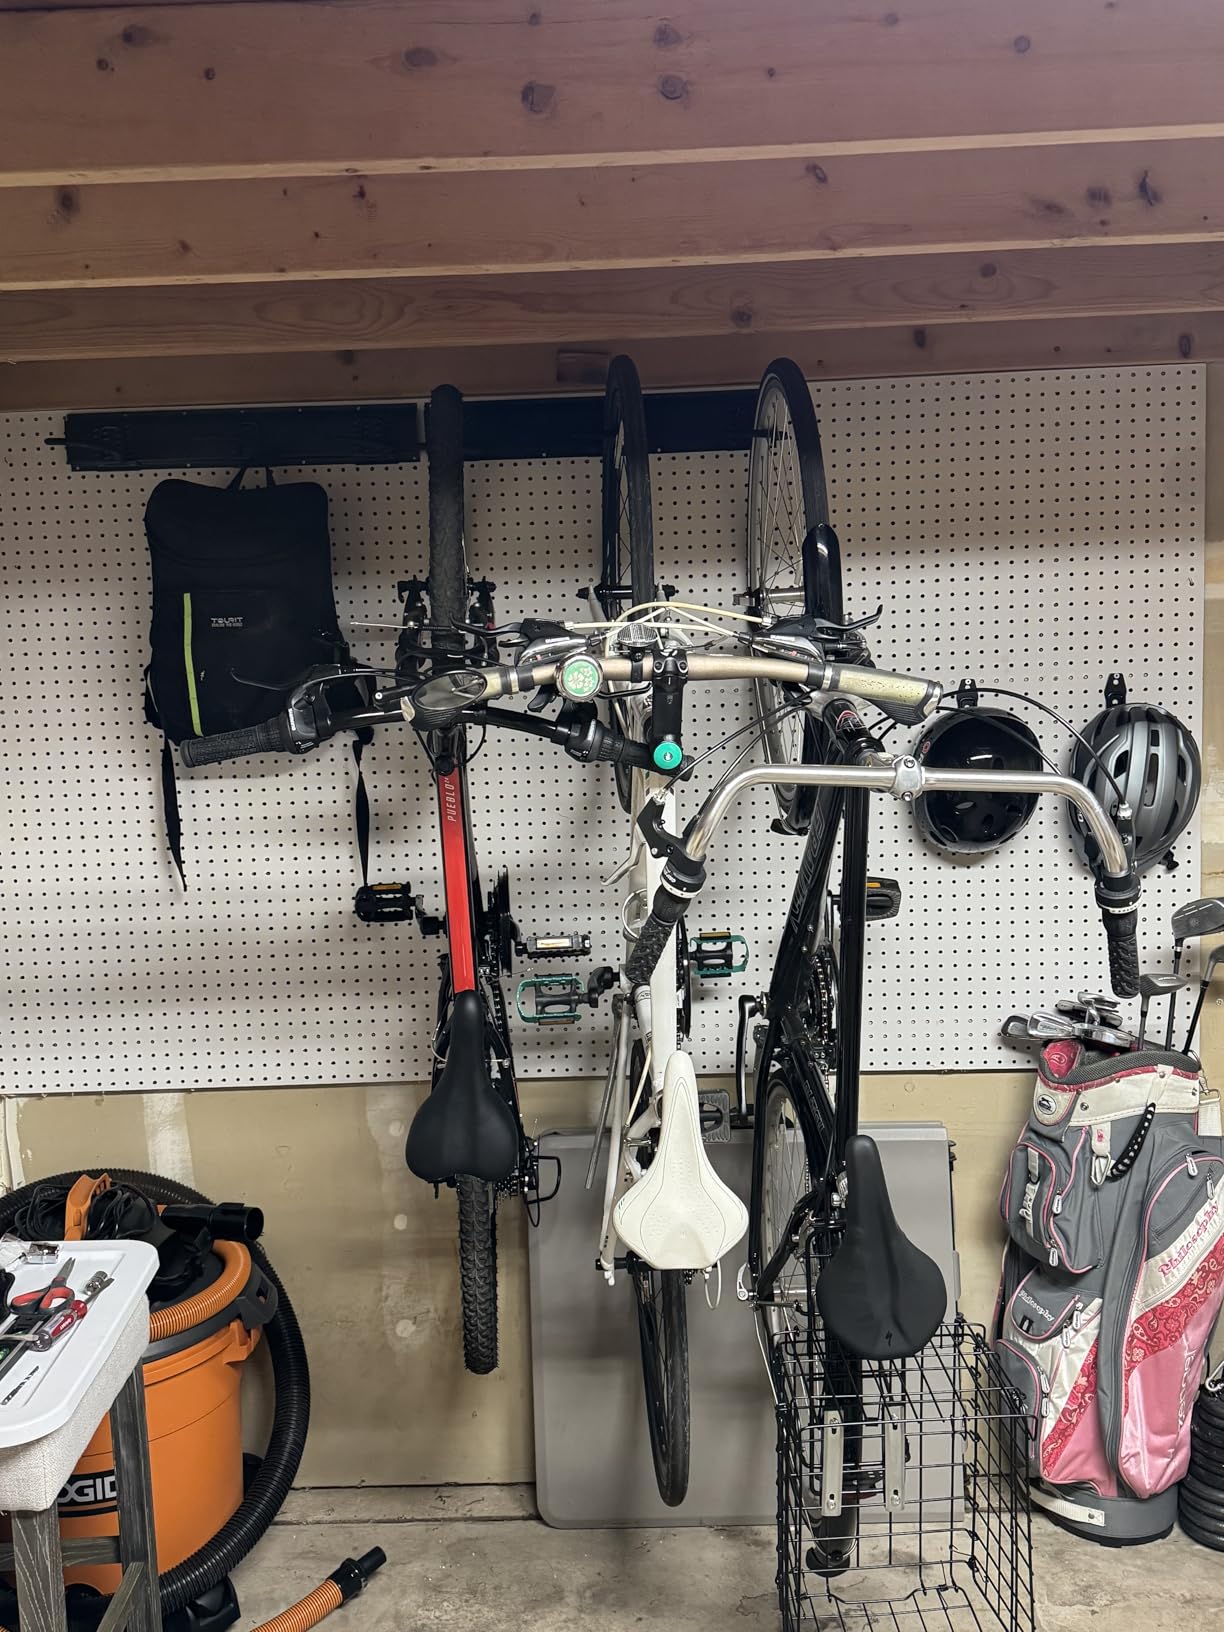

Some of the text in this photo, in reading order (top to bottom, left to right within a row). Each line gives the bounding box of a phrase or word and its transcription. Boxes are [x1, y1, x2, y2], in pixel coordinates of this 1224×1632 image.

[210, 616, 243, 624] TOURIT
[445, 783, 457, 822] PUEBLO
[1158, 1200, 1219, 1277] Philosophy
[1018, 1289, 1055, 1322] Philosophy
[57, 1475, 117, 1503] DGID
